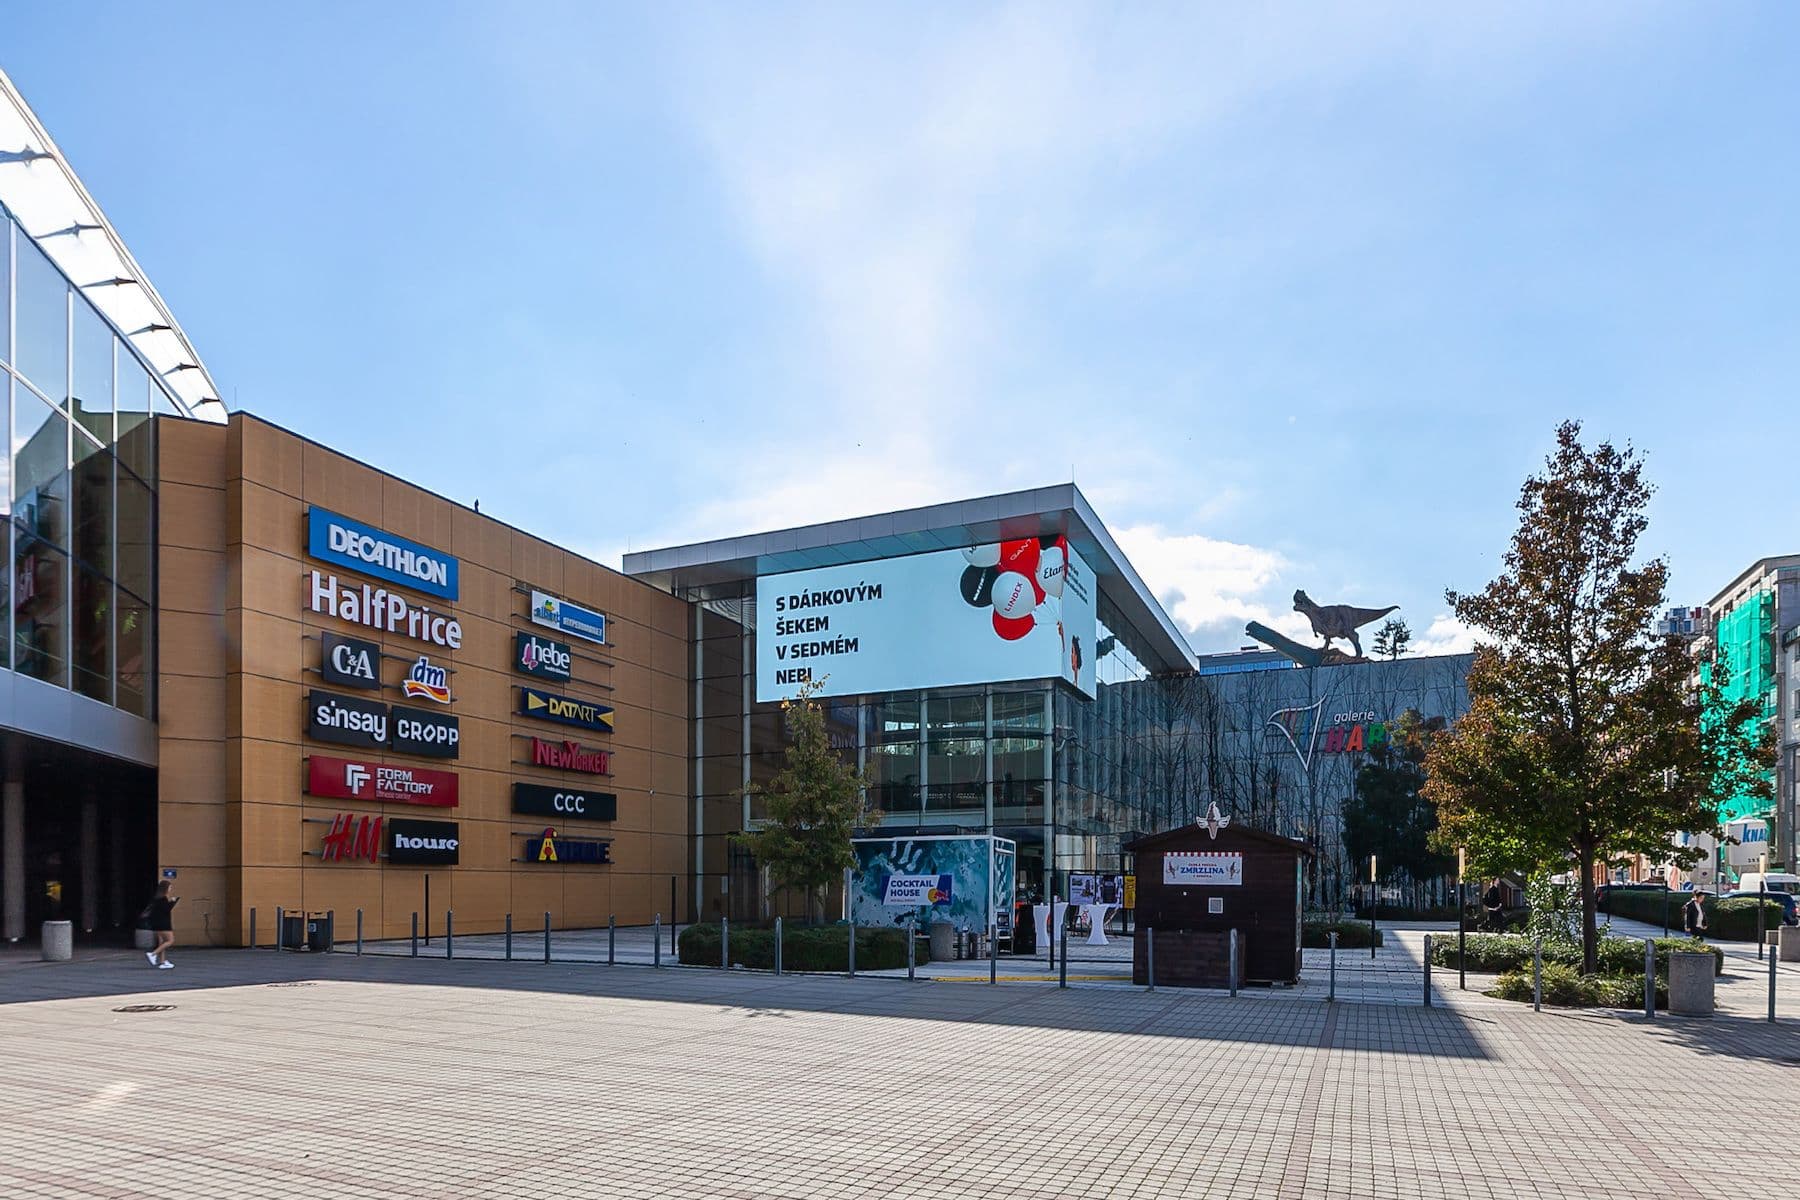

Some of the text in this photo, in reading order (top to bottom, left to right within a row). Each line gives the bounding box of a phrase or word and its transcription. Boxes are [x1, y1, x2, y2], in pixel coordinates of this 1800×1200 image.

[328, 523, 447, 587] DECATHLON
[775, 583, 882, 612] S DÁRKOVÝM
[1003, 581, 1023, 612] LINDEX
[310, 570, 462, 650] HalfPrice
[775, 616, 829, 636] ŠEKEM
[531, 637, 570, 669] hebe
[776, 635, 859, 660] V SEDMÉM
[331, 644, 375, 680] C&A
[412, 657, 446, 687] dm
[775, 667, 812, 685] NEBI
[316, 700, 388, 742] sinsay
[549, 693, 598, 724] DATART
[1333, 708, 1375, 724] galerie
[398, 718, 459, 746] CROPP
[376, 767, 413, 782] FORM
[376, 779, 434, 795] FACTORY
[554, 792, 585, 813] CCC
[395, 833, 458, 851] house
[890, 880, 934, 888] COCKTAIL
[890, 889, 920, 897] HOUSE
